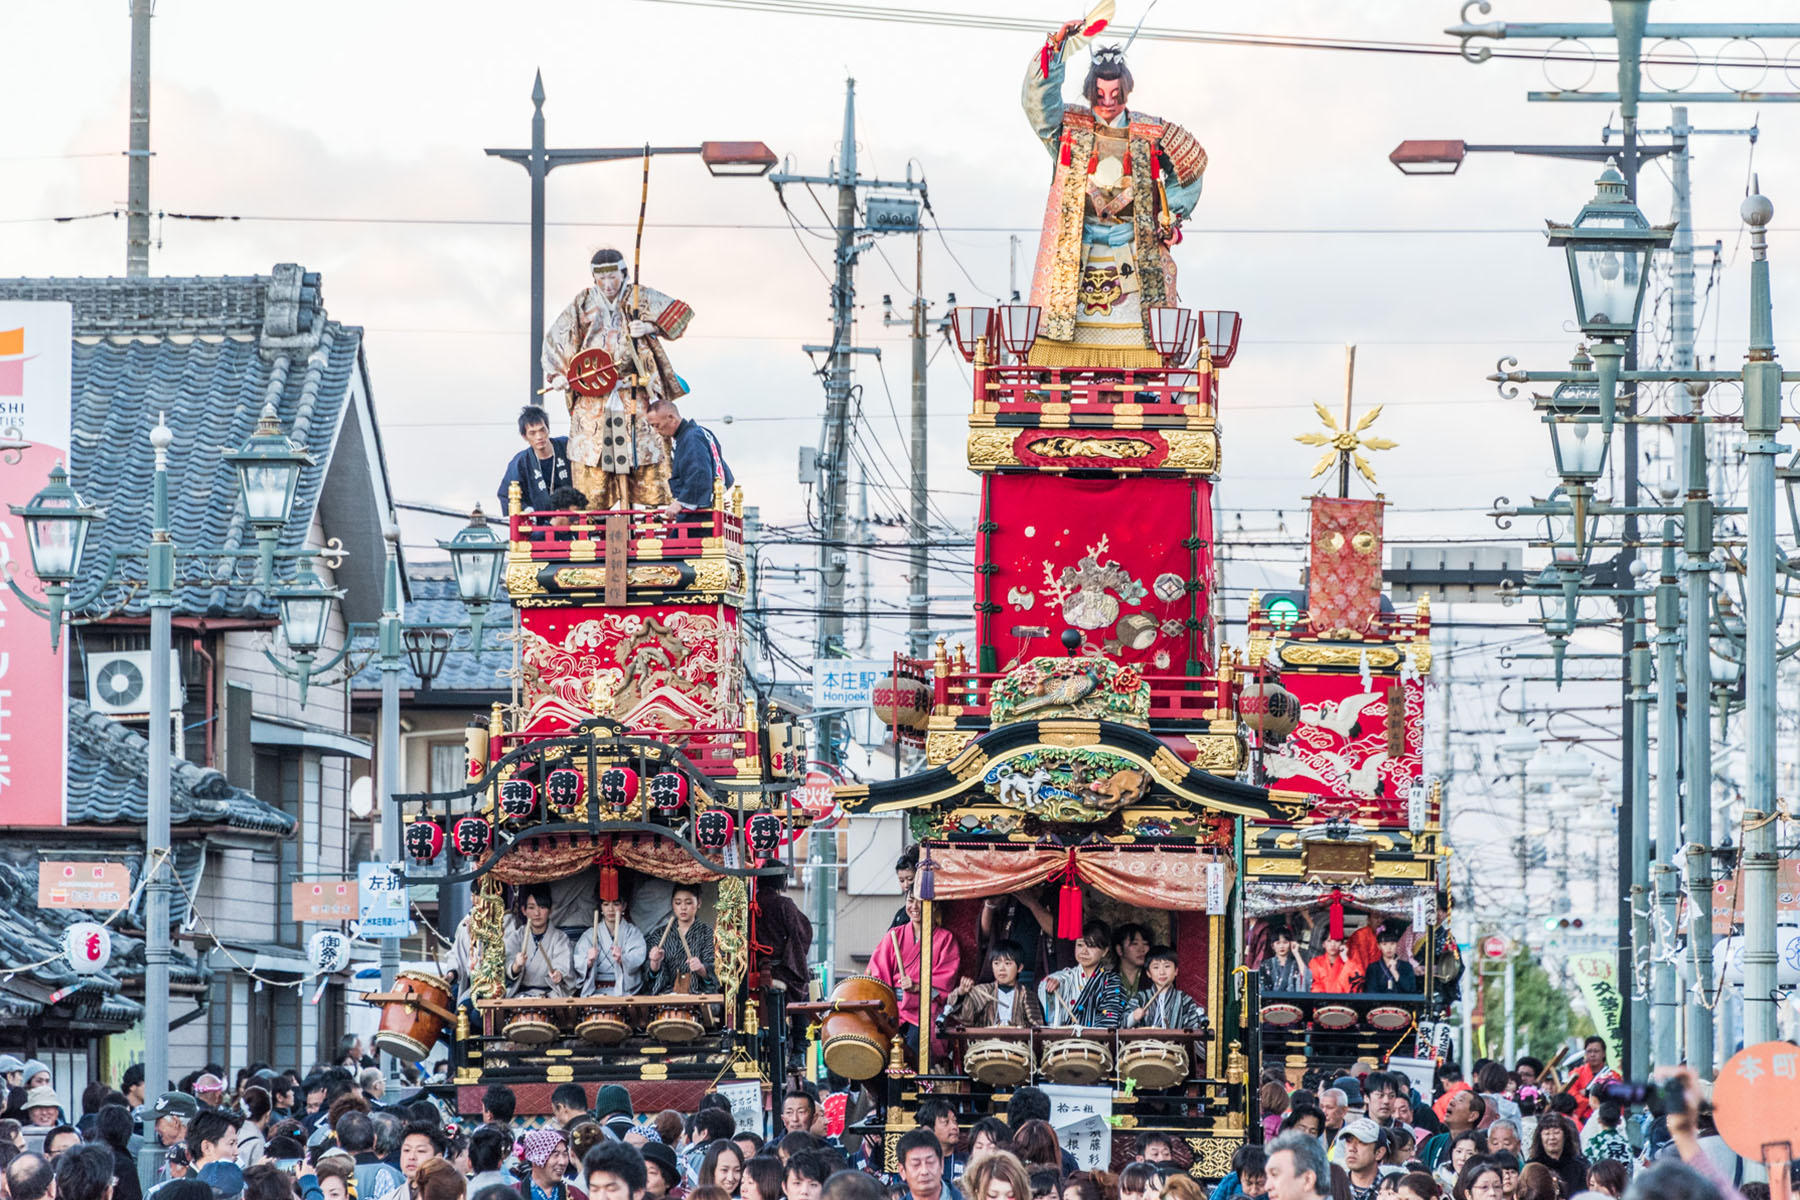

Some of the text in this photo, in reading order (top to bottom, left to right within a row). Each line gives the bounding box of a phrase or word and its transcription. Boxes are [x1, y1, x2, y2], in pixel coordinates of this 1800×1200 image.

[823, 690, 869, 703] Honjoeki
[501, 781, 533, 816] 神功
[549, 771, 579, 806] 神功
[650, 774, 681, 808] 神功
[459, 819, 490, 856] 神功
[698, 812, 728, 848] 神功
[751, 815, 781, 851] 神功
[1736, 1053, 1798, 1085] 本町
[1057, 1102, 1095, 1114] 拾二組
